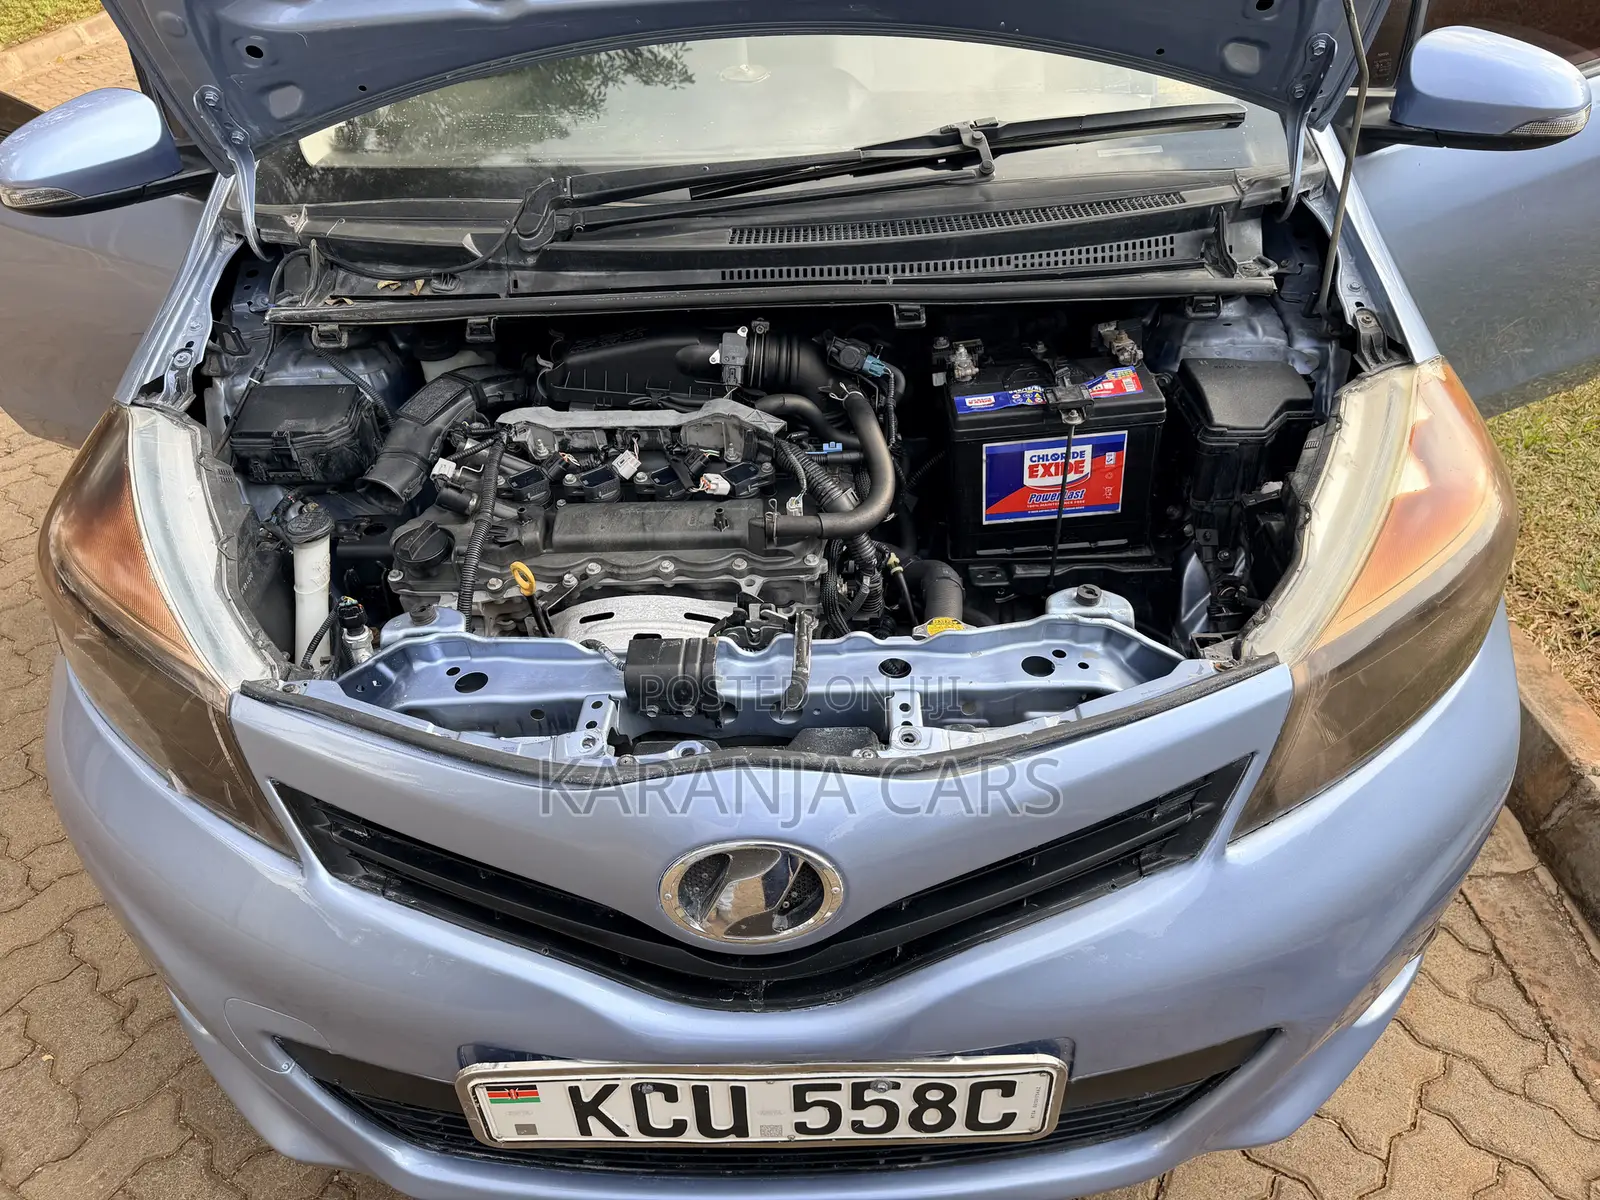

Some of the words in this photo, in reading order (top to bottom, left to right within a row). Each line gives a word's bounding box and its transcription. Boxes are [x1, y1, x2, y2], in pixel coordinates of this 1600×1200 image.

[1030, 451, 1086, 463] CHLORDE
[1028, 459, 1086, 479] EXIDE
[568, 1081, 750, 1138] KCU
[792, 1080, 1018, 1135] 558C
